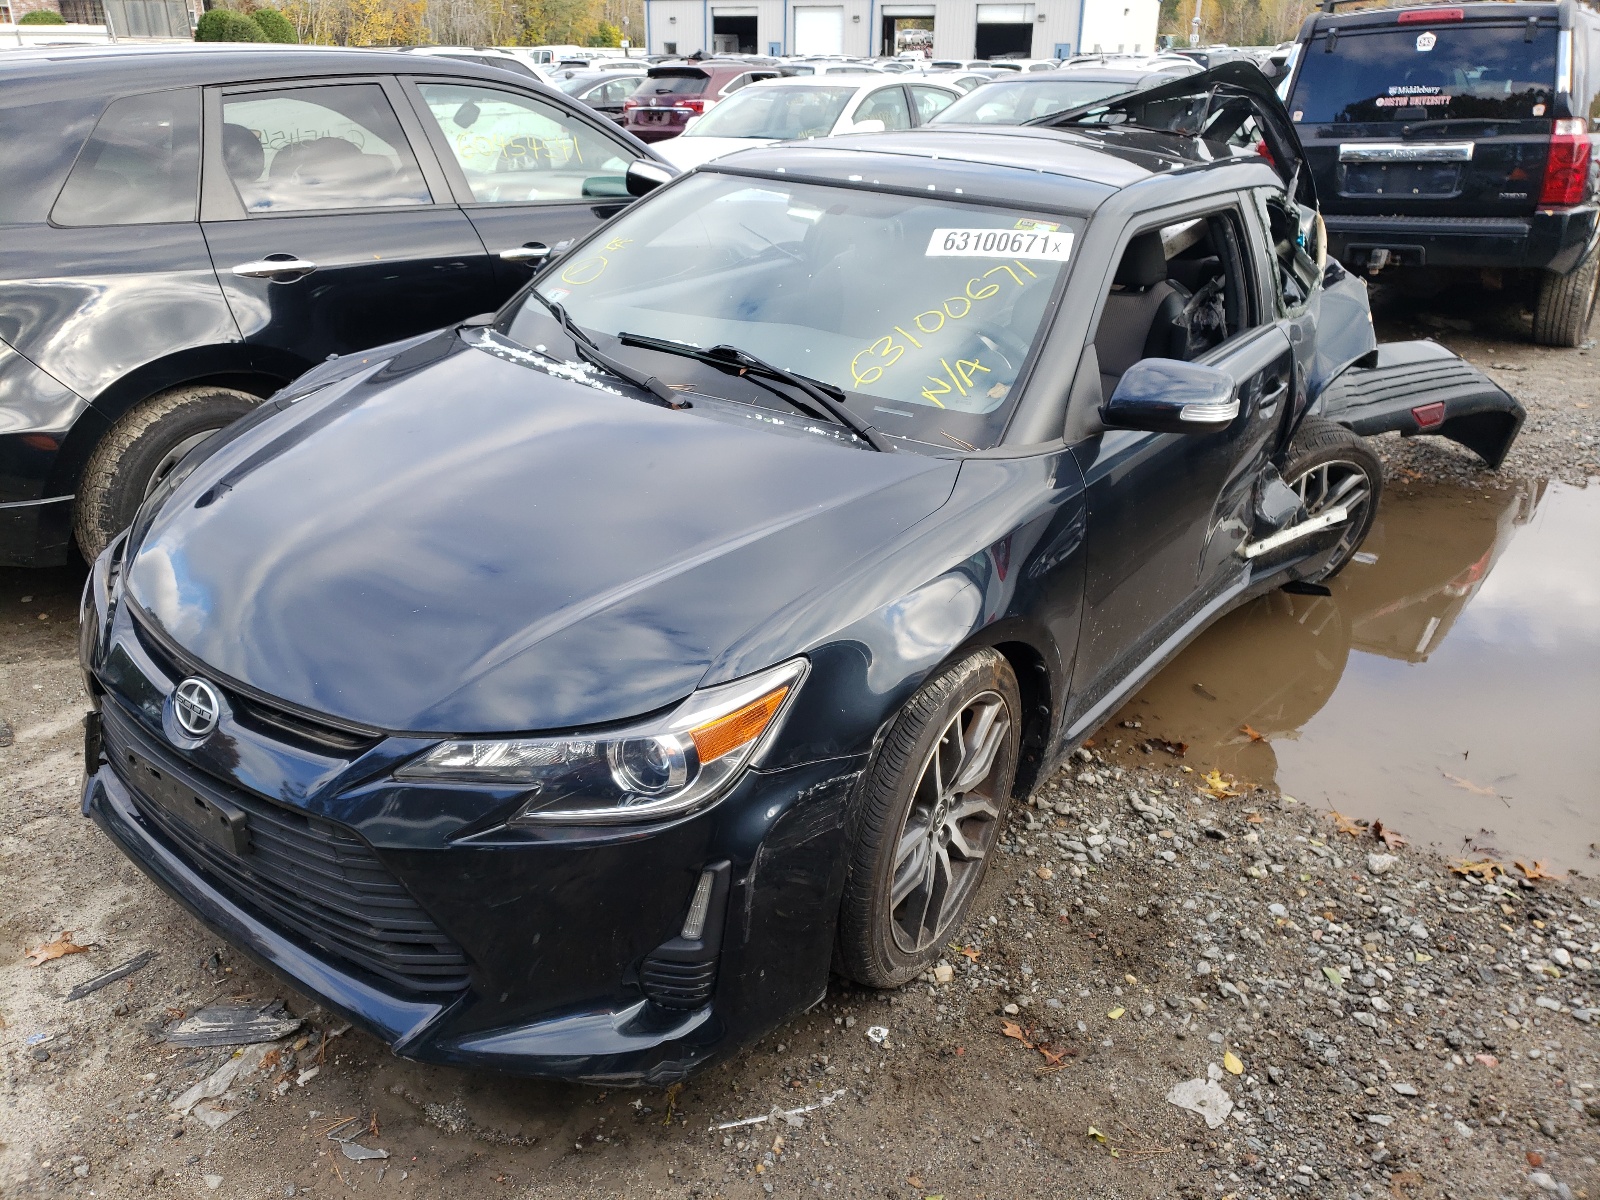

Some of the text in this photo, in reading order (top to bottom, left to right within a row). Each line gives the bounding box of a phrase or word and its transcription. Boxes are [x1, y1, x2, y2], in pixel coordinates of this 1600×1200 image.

[1398, 85, 1440, 95] Middlebury
[943, 231, 1050, 254] 63100671
[851, 259, 1037, 389] 63100671
[921, 357, 991, 409] N/A
